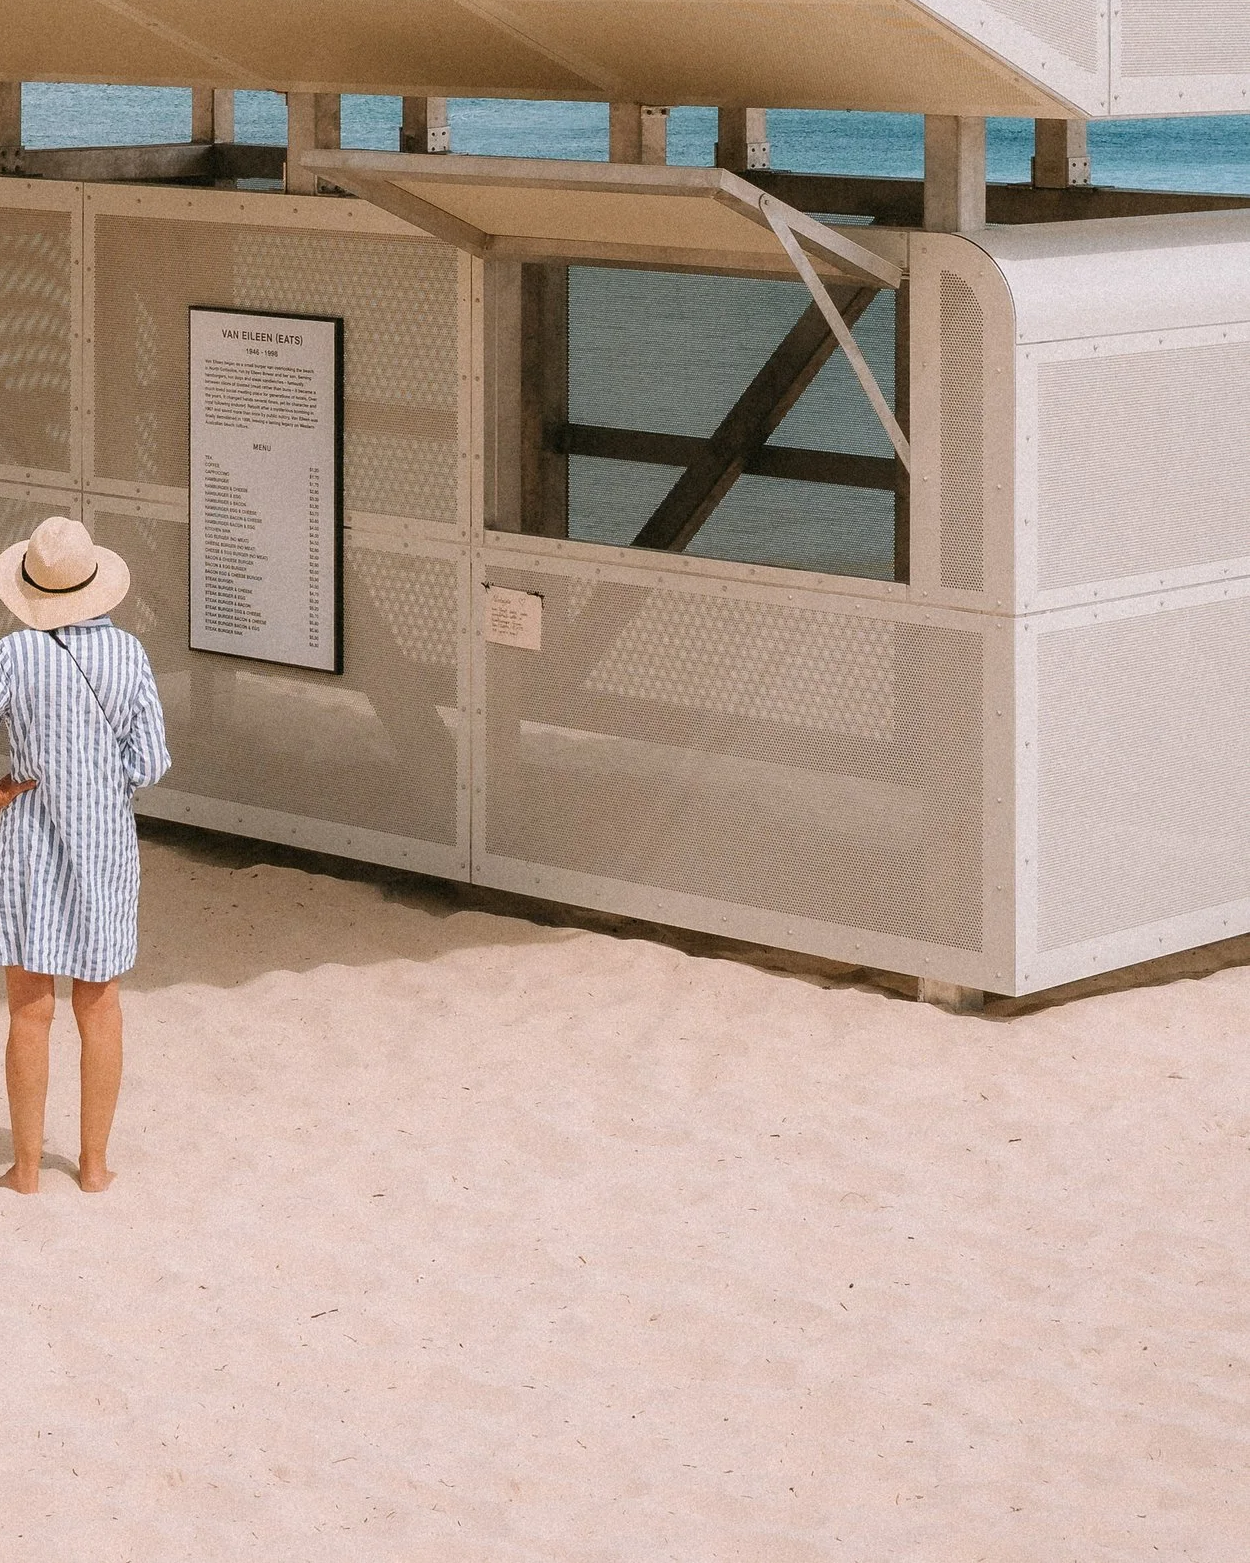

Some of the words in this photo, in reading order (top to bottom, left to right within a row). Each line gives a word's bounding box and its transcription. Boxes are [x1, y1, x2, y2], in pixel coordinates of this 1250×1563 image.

[222, 329, 239, 340] VAN
[242, 331, 272, 343] EILEEN
[276, 333, 303, 346] (EATS)
[246, 348, 259, 356] 1946
[253, 444, 271, 452] MENU
